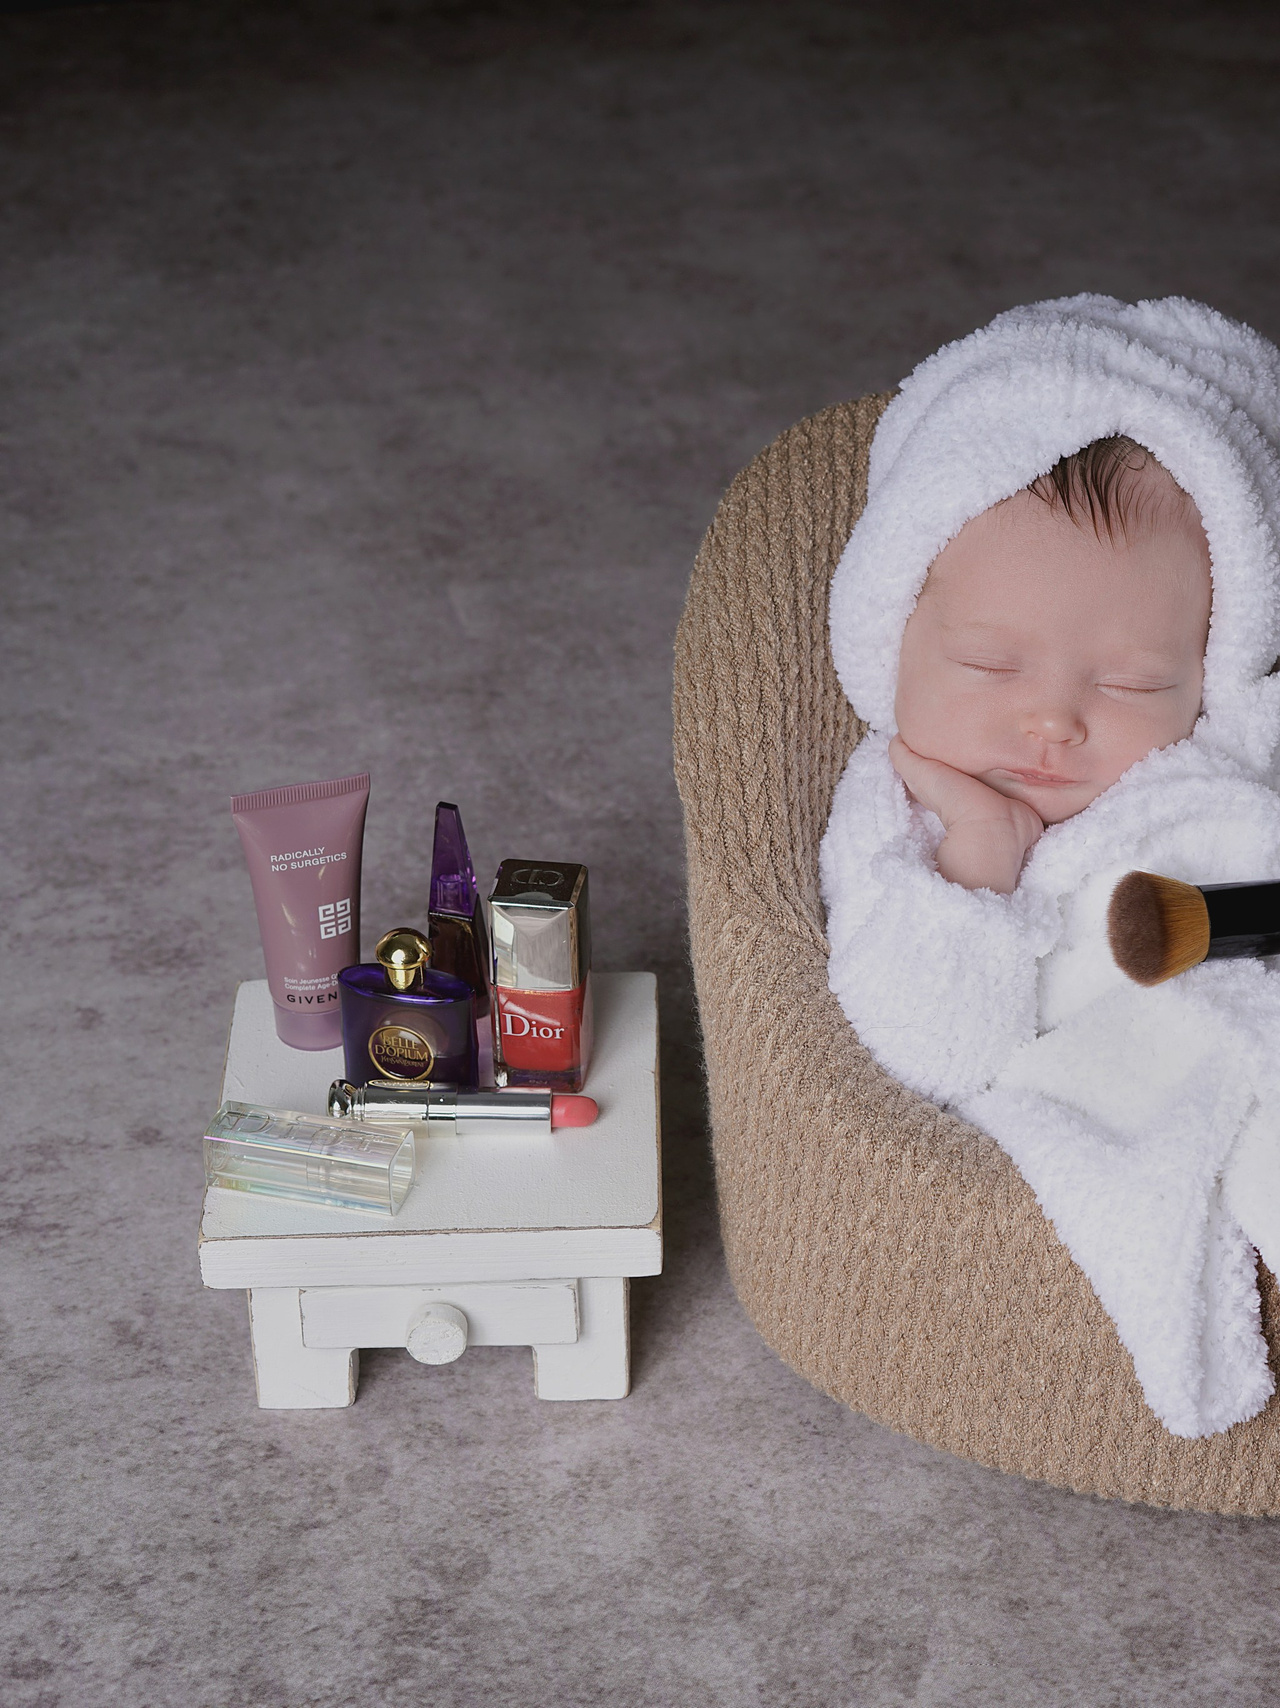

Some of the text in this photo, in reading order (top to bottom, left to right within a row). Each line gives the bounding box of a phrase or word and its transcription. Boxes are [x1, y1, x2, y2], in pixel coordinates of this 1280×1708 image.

[270, 846, 325, 863] RADICALLY
[271, 852, 347, 872] NO SURGETICS
[284, 982, 316, 991] Complete
[286, 991, 338, 1005] GIVEN
[502, 1013, 565, 1039] Dior
[383, 1035, 419, 1050] BELLE
[374, 1044, 429, 1062] D'OPIUM
